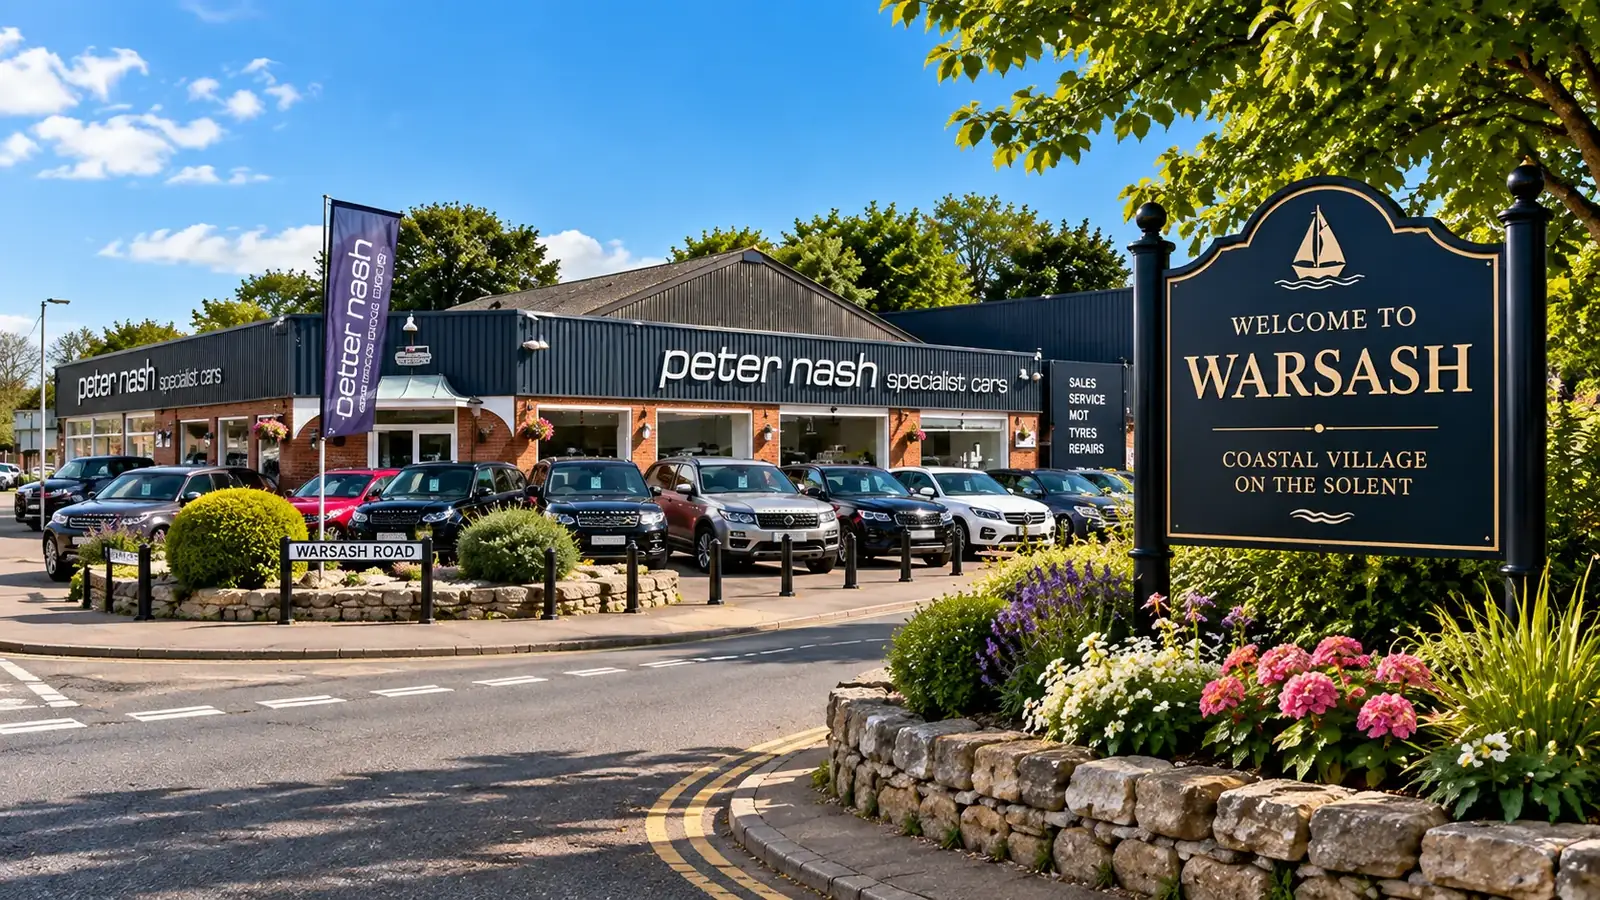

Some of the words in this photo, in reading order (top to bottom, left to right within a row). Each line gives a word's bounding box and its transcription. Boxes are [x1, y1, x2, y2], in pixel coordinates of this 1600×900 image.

[1231, 308, 1368, 336] WELCOME
[1377, 306, 1417, 328] TO
[659, 346, 782, 389] peter
[789, 352, 878, 389] nash
[886, 369, 967, 394] specialist
[971, 375, 1008, 394] cars
[1184, 343, 1473, 400] WARSASH
[77, 369, 117, 406] peter
[119, 358, 156, 394] nash
[159, 367, 199, 395] specialist
[200, 367, 222, 386] cars
[1068, 377, 1097, 389] SALES
[1068, 393, 1106, 405] SERVICE
[1068, 409, 1090, 421] MOT
[1068, 427, 1098, 439] TYRES
[1068, 443, 1105, 455] REPAIRS
[1222, 450, 1319, 469] COASTAL
[1327, 450, 1428, 470] VILLAGE
[1234, 475, 1266, 493] ON
[1273, 476, 1317, 494] THE
[1323, 477, 1413, 496] SOLENT
[295, 545, 368, 558] WARSASH
[373, 545, 415, 558] ROAD
